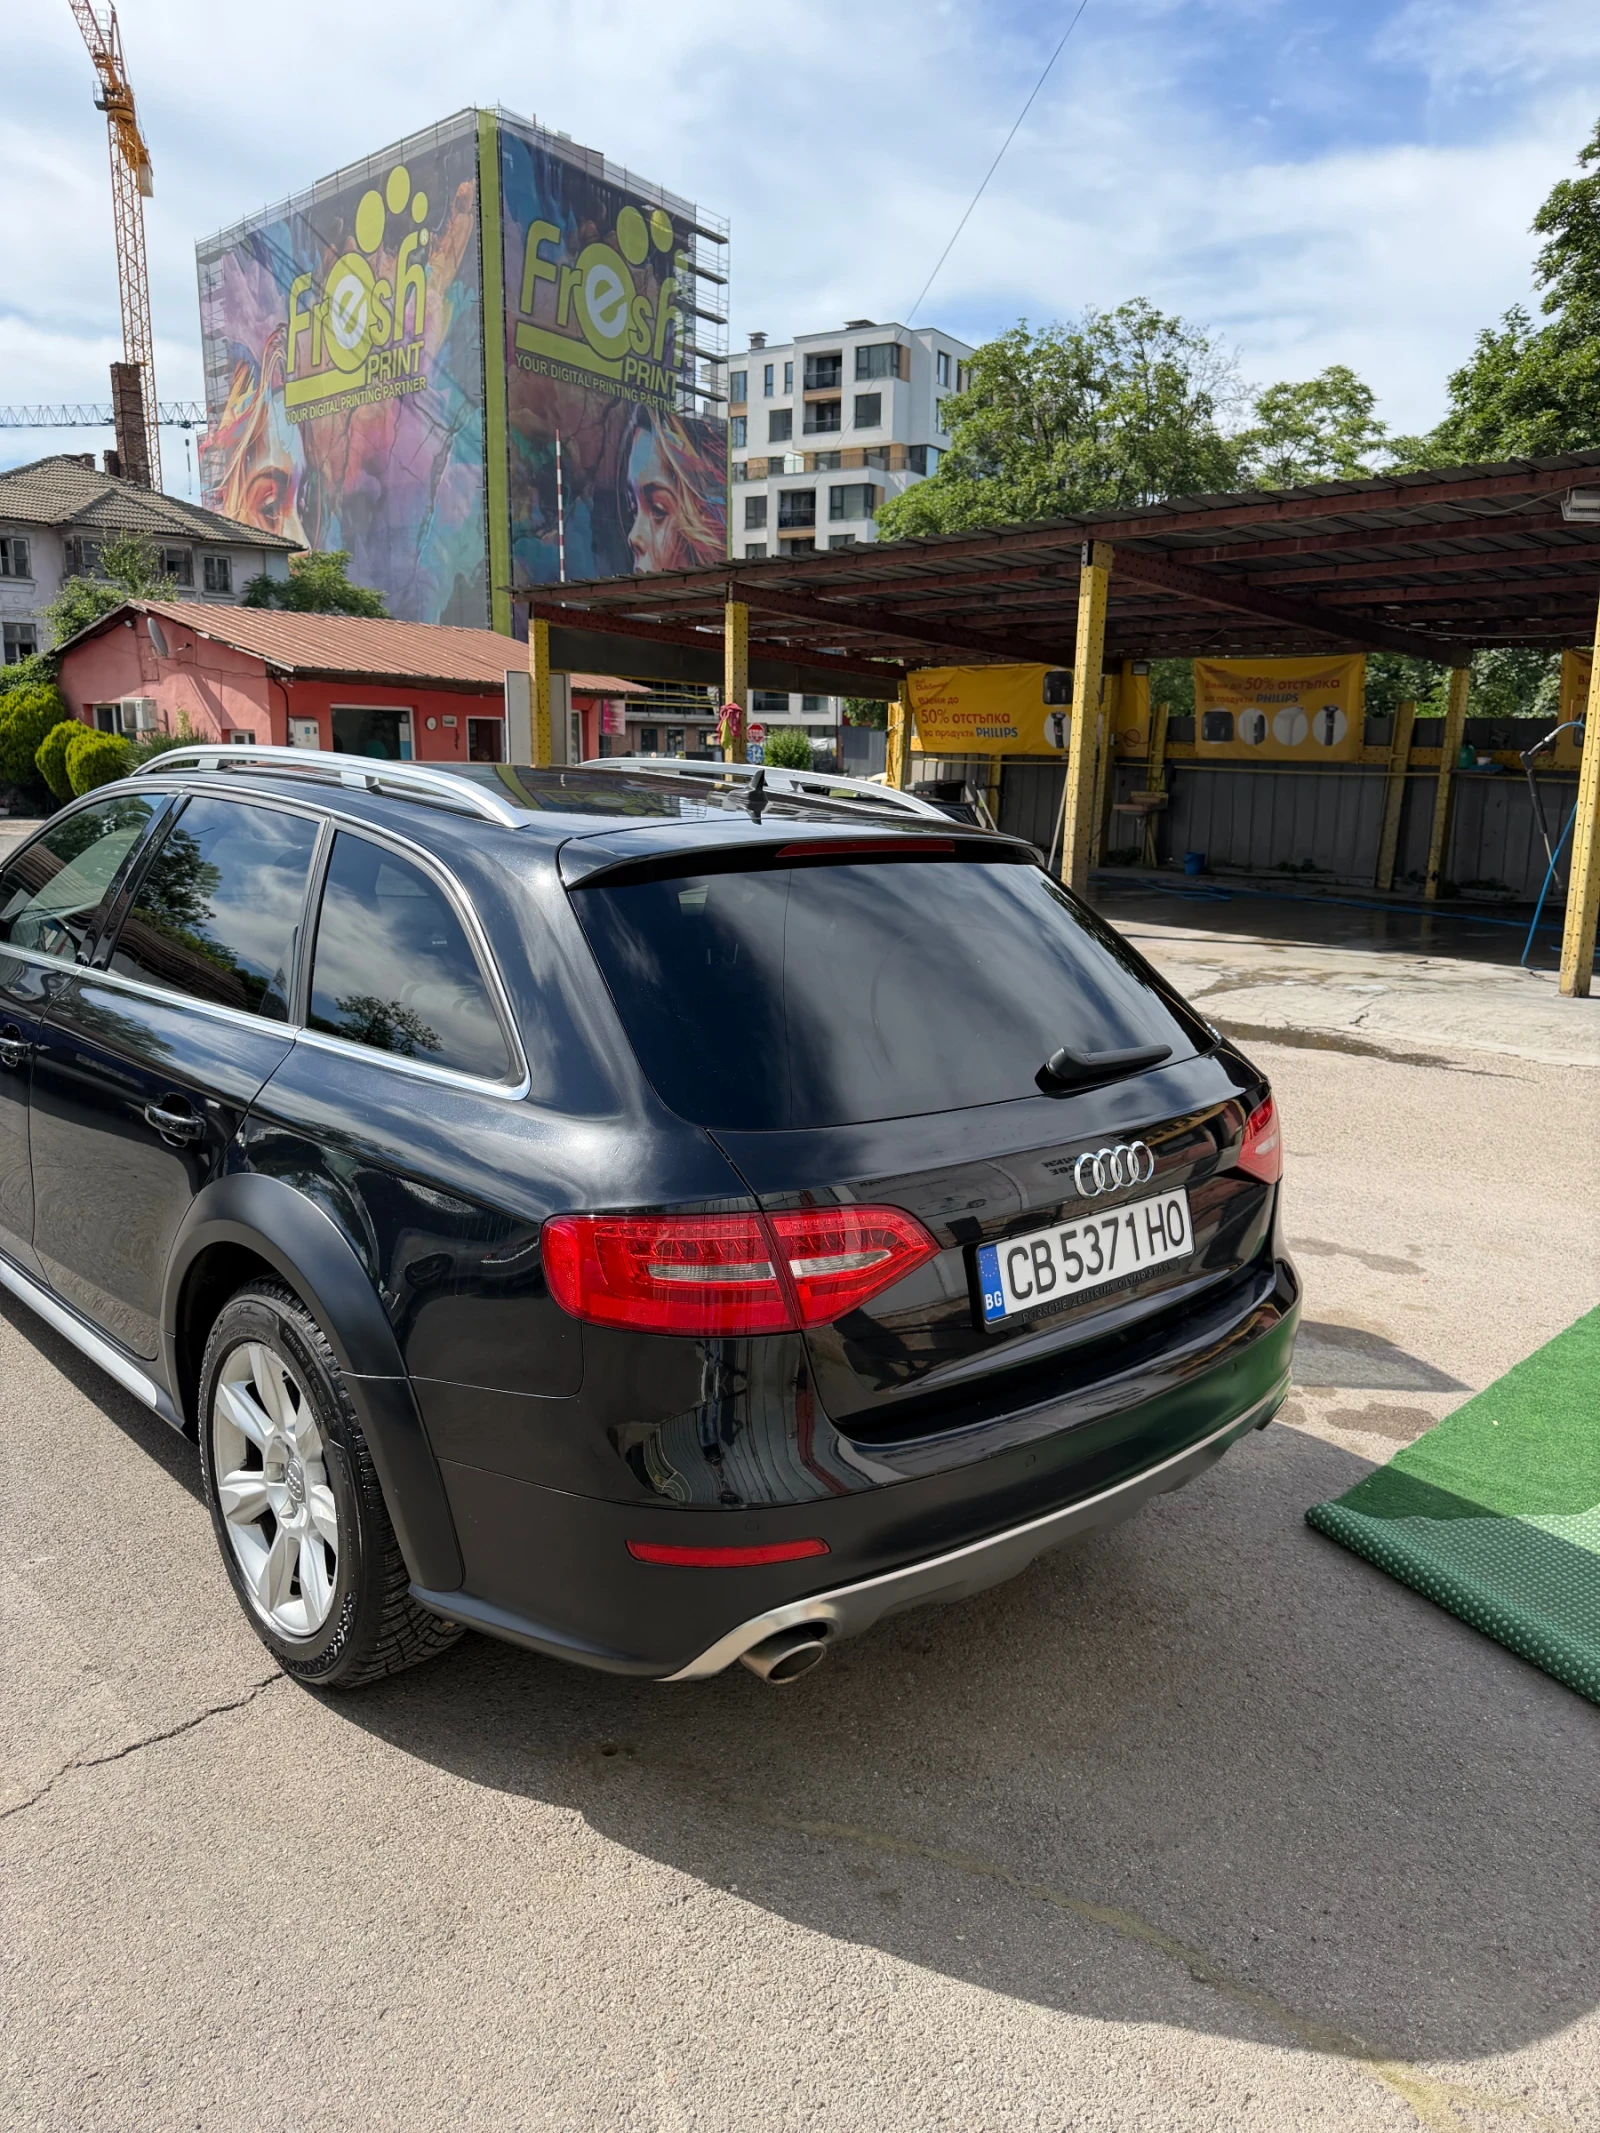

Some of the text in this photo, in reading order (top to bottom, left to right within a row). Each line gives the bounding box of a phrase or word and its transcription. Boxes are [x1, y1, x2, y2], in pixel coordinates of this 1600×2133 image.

[367, 341, 424, 384] PRINT
[516, 354, 548, 376] YOUR
[551, 363, 591, 388] DIGITAL
[593, 378, 638, 402] PRINTING
[624, 357, 678, 396] PRINT
[286, 376, 427, 425] YOUR DIGITAL PRINTING PARTNER
[1244, 677, 1275, 690] 50%
[1278, 678, 1341, 689] отстъпка
[947, 696, 959, 705] до
[1256, 693, 1299, 703] PHILIPS
[921, 709, 1011, 725] 50% отстъпка
[935, 730, 974, 740] продукти
[976, 727, 1018, 738] PHILIPS
[1007, 1200, 1185, 1300] CB 5371 HO
[984, 1293, 1002, 1310] BG
[1022, 1300, 1068, 1323] PORSCHE
